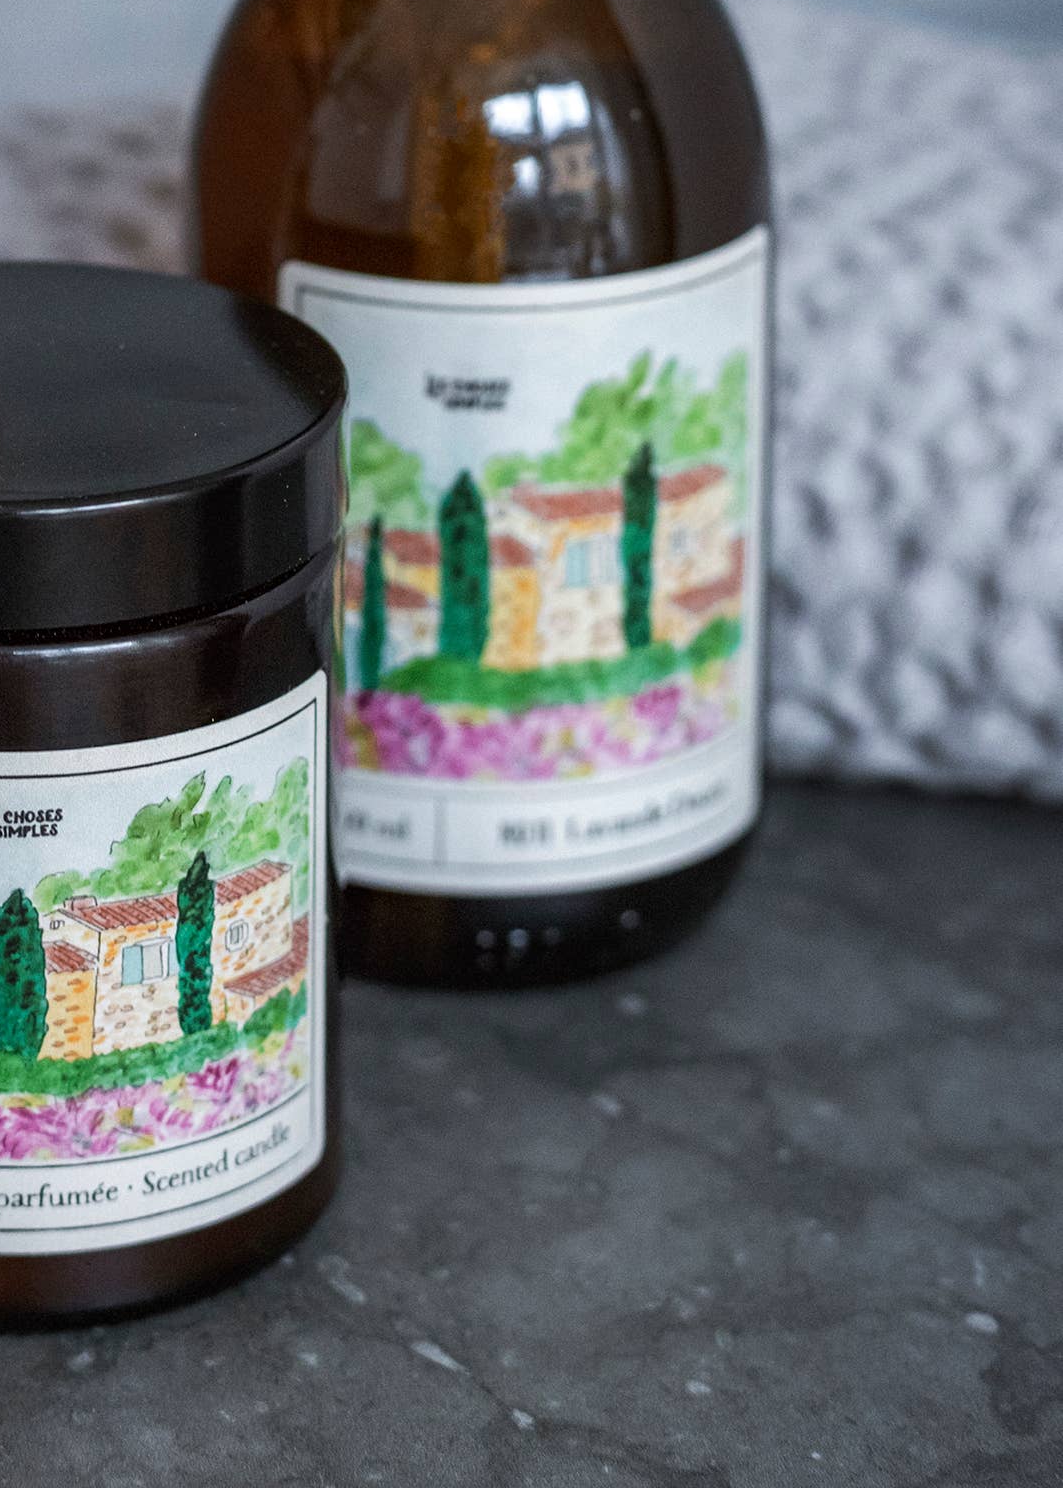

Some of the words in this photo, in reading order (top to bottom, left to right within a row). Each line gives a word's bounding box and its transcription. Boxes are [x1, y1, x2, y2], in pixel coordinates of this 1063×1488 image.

[3, 808, 63, 824] CHOSES
[142, 1147, 229, 1195] Scented
[235, 1121, 290, 1166] candle
